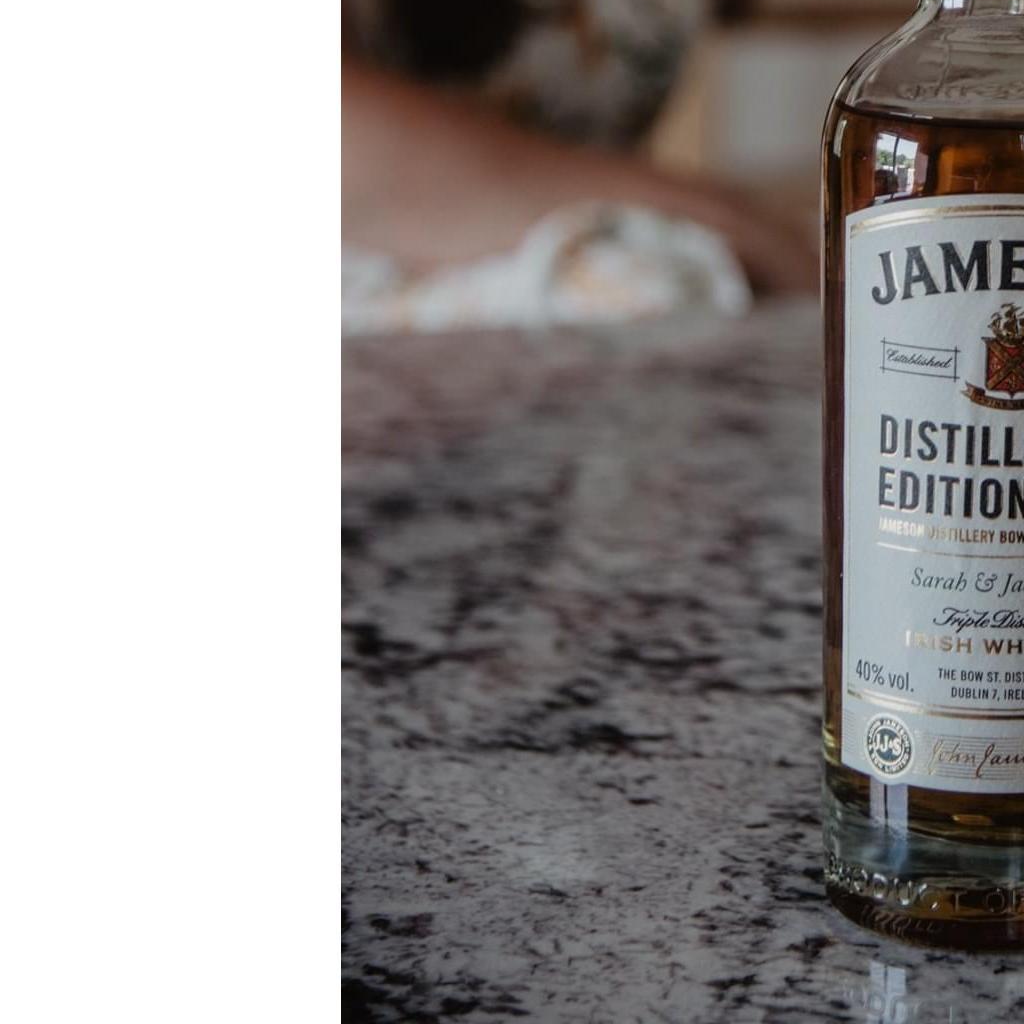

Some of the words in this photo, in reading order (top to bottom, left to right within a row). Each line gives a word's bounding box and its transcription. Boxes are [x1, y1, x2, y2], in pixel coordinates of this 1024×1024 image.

[886, 348, 953, 369] Established
[879, 517, 925, 537] JAMESON
[928, 526, 996, 544] DISTILLERY
[911, 566, 967, 593] Sarah
[975, 571, 998, 593] &
[932, 607, 991, 633] Triple
[904, 629, 973, 654] IRISH
[856, 659, 885, 686] 40%
[888, 671, 914, 692] vol.
[938, 668, 956, 682] THE
[960, 669, 984, 683] BOW
[950, 687, 989, 700] DUBLIN
[991, 687, 1000, 702] 7,
